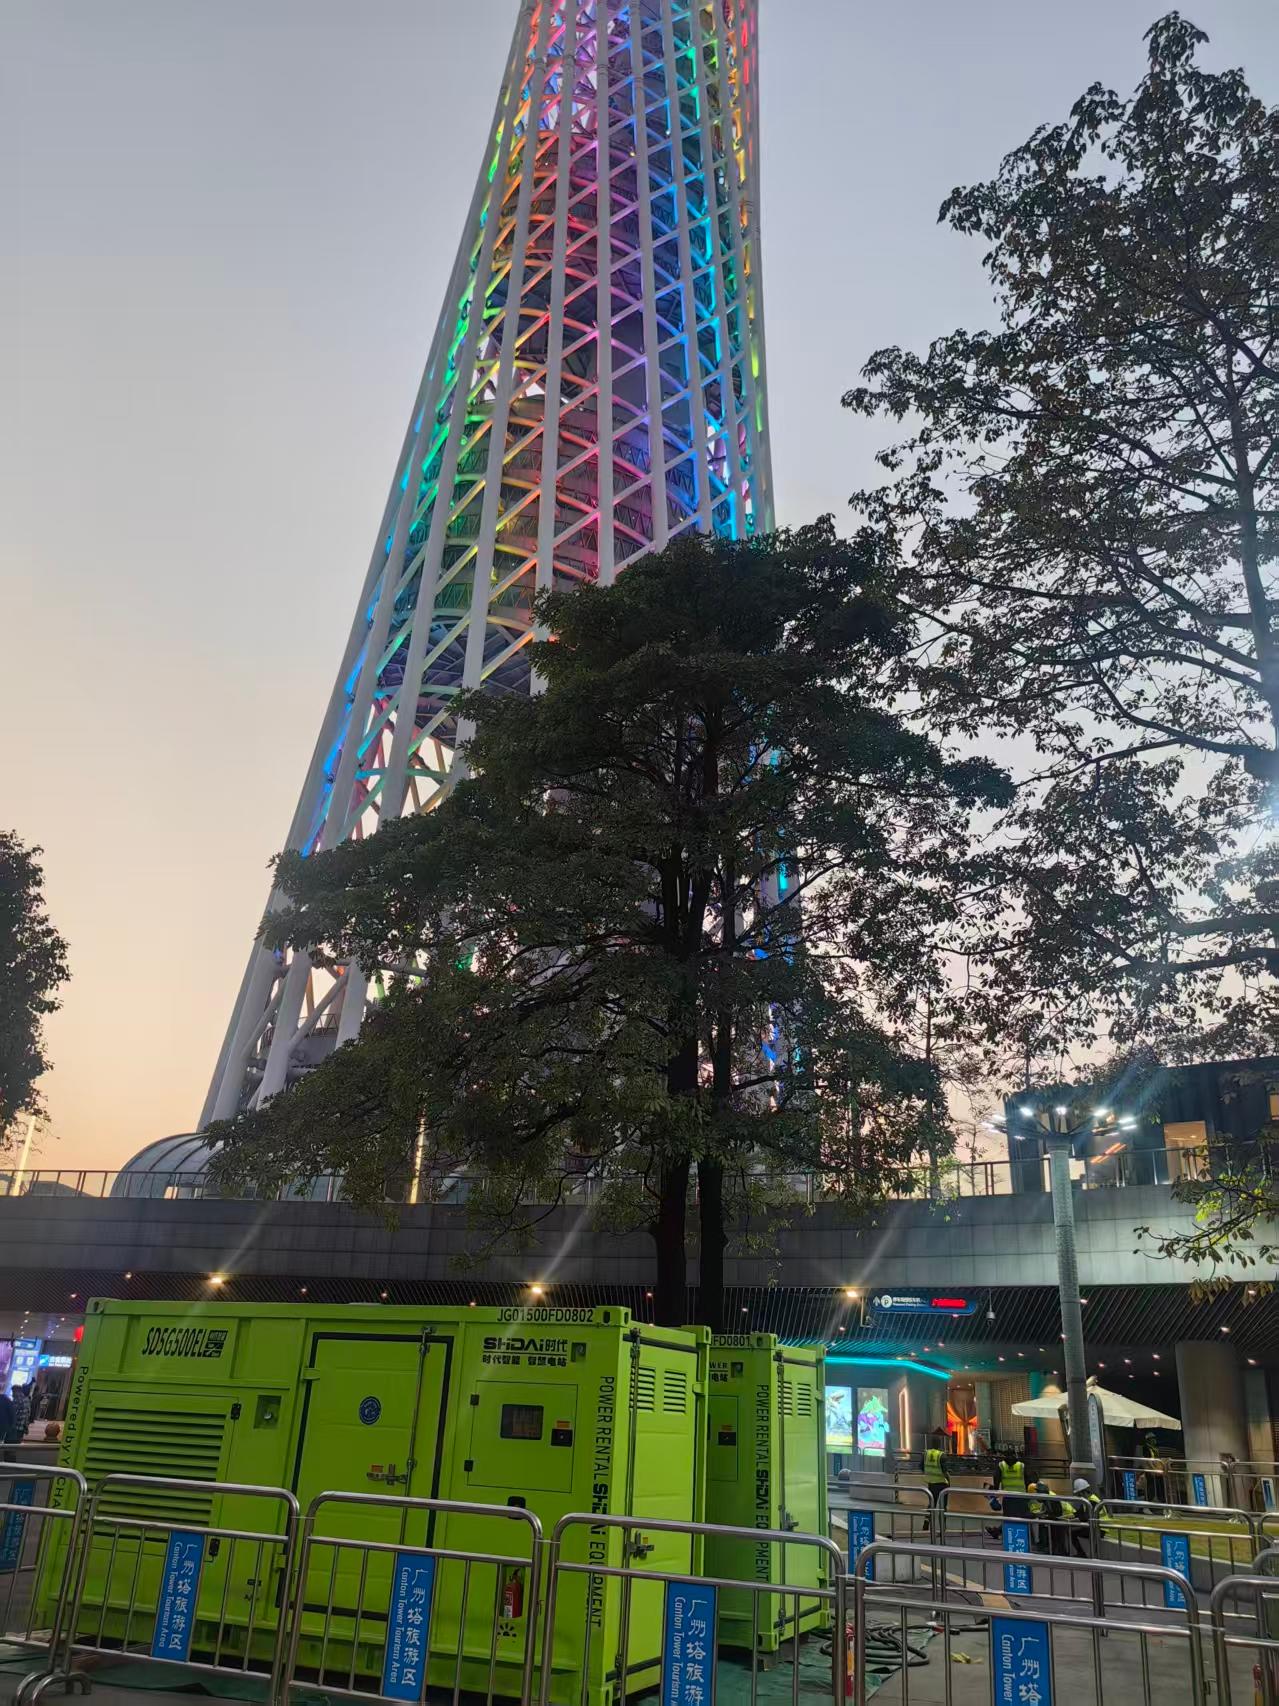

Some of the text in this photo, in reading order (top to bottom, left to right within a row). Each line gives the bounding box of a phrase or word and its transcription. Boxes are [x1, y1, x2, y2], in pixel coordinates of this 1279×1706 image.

[496, 1308, 593, 1322] JG01500FD0802
[545, 1338, 568, 1353] 时代
[710, 1335, 751, 1347] FD0801
[67, 1366, 89, 1432] Powered
[596, 1376, 615, 1423] POWER
[755, 1384, 769, 1422] POWER
[62, 1436, 75, 1453] by
[593, 1427, 612, 1481] RENTAL
[755, 1424, 769, 1468] RENTAL
[171, 1541, 183, 1569] Canton
[755, 1514, 769, 1582] EQPMENT
[167, 1571, 178, 1593] Tower
[168, 1543, 198, 1650] 广州塔旅游区
[390, 1567, 411, 1684] Canton Tower Tourism Area
[401, 1568, 429, 1686] 广州塔旅游区
[674, 1596, 686, 1629] Canton
[159, 1627, 169, 1648] Area
[673, 1631, 685, 1659] Tower
[670, 1662, 683, 1698] Tourism
[1001, 1634, 1016, 1702] Canton Tower
